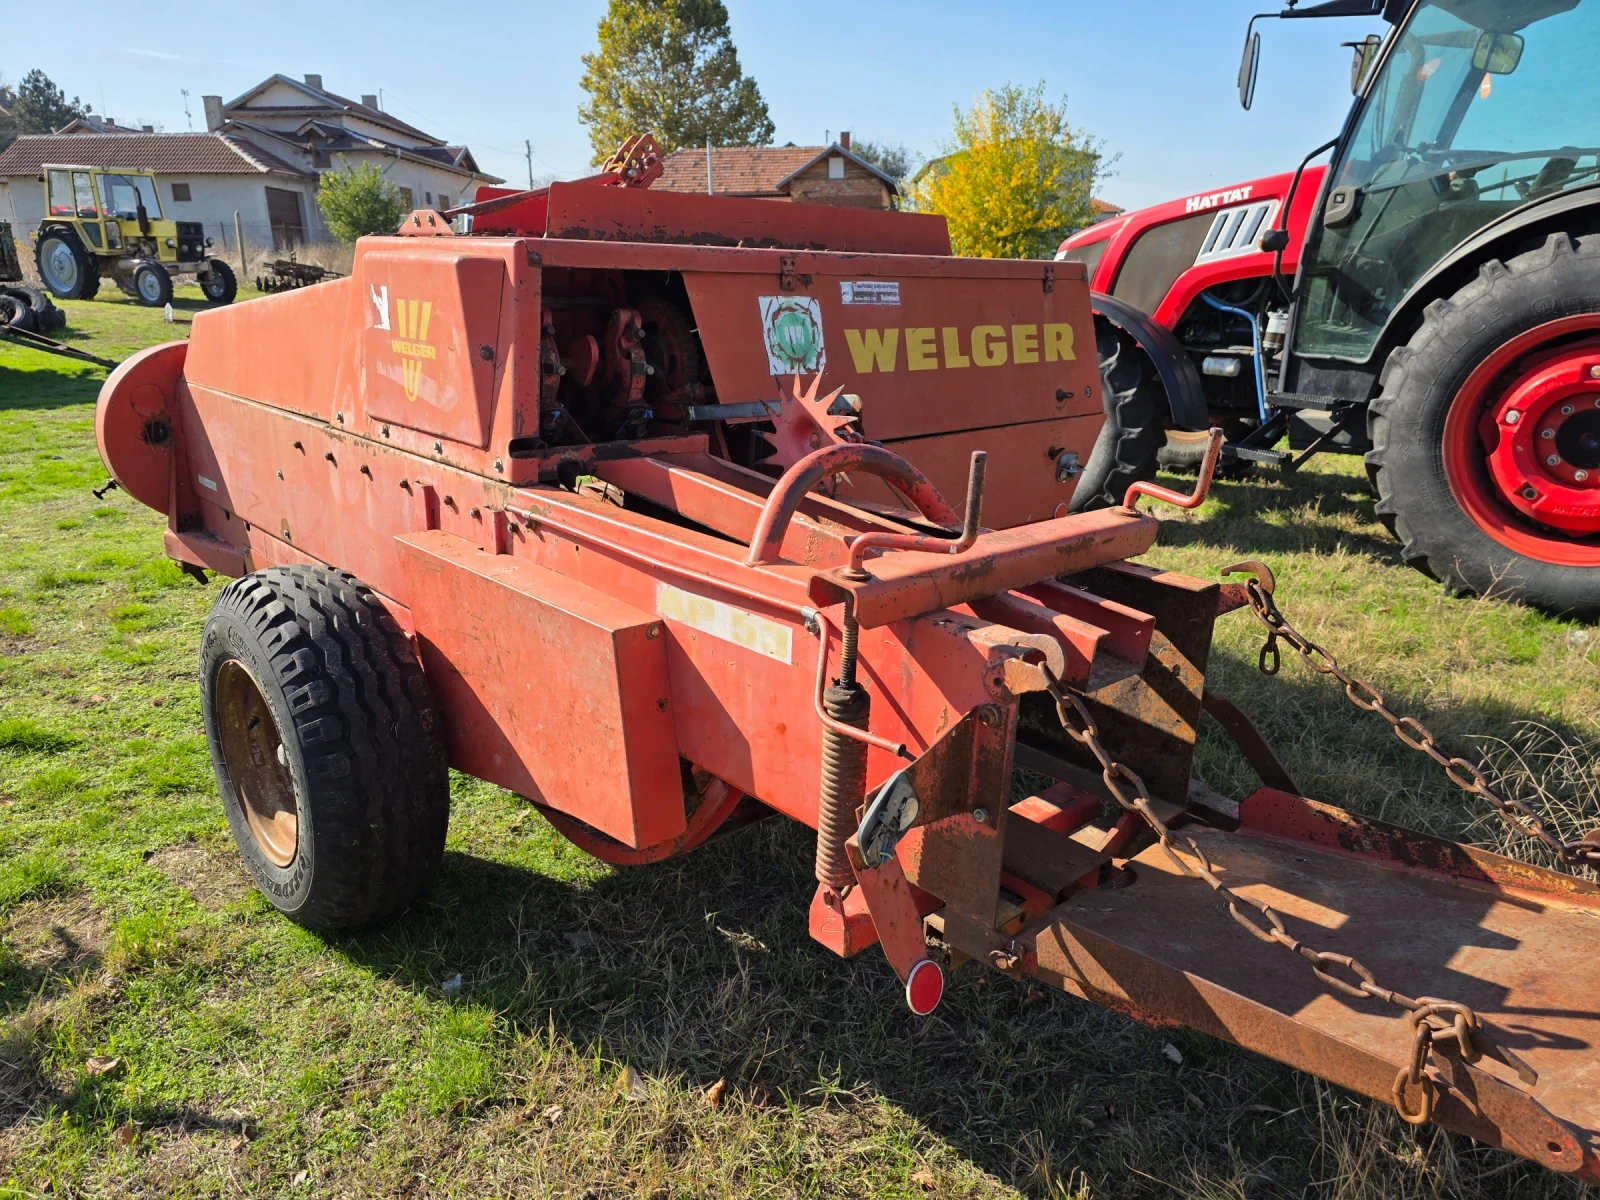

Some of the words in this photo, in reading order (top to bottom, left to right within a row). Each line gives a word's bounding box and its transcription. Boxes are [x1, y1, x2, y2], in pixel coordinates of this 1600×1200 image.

[1185, 186, 1253, 213] HATTAT
[391, 340, 436, 360] WELGER
[844, 323, 1077, 374] WELGER
[659, 586, 714, 625] AP
[730, 610, 789, 659] 53
